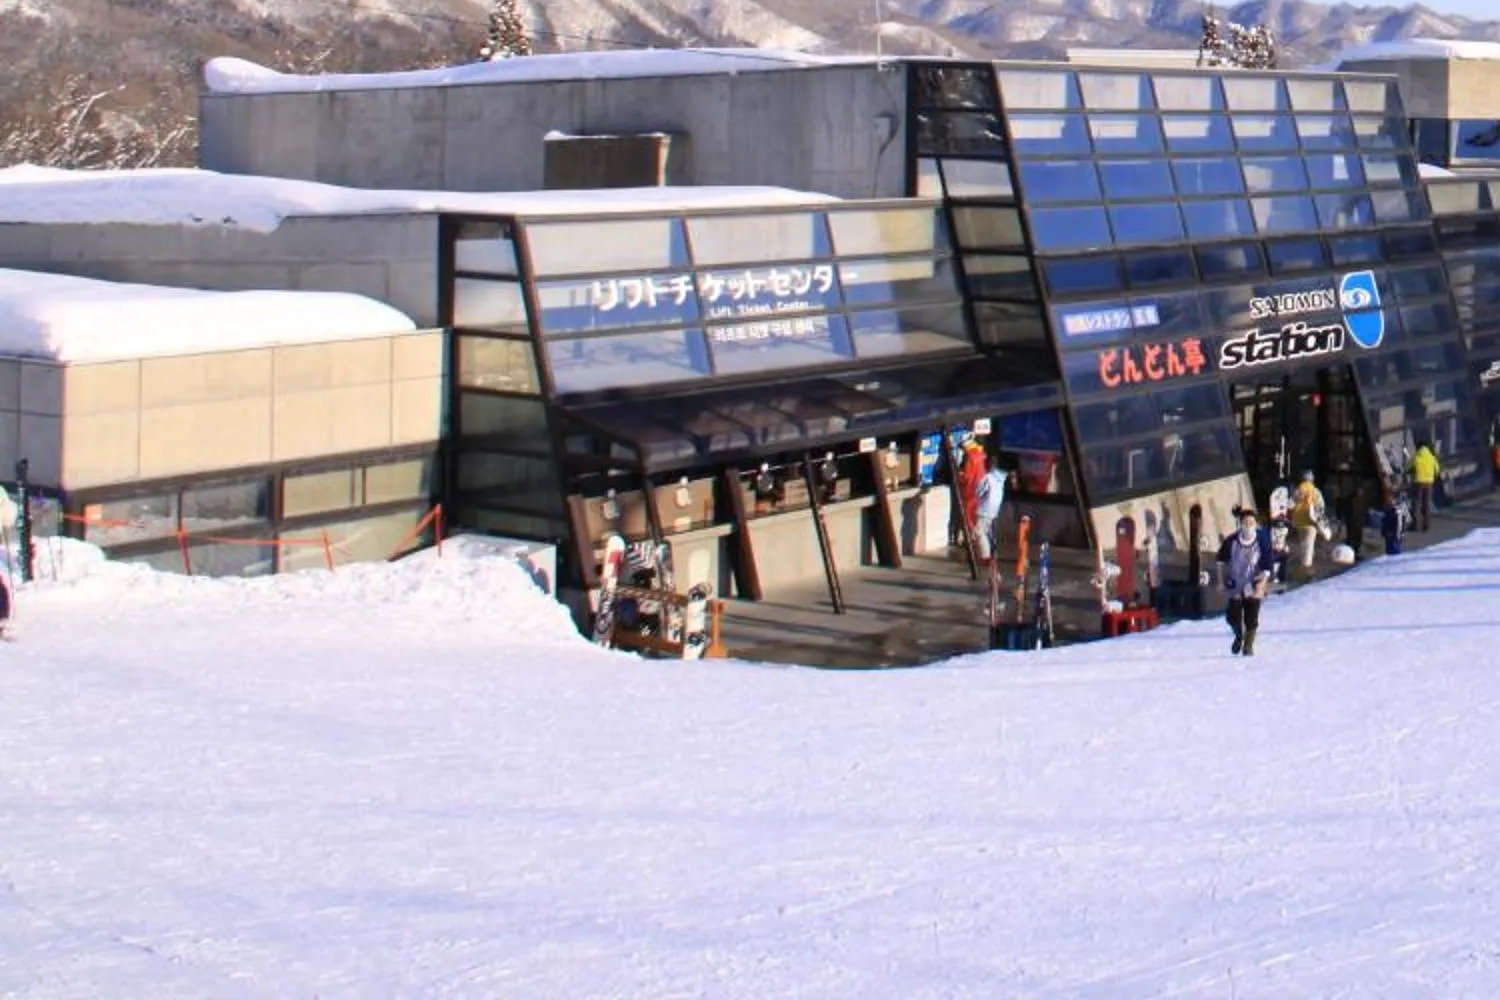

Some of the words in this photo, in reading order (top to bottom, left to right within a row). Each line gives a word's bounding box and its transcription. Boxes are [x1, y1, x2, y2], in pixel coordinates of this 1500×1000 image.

[592, 264, 858, 311] リフトチケットセンター
[1249, 288, 1337, 319] SALOMON
[1098, 337, 1206, 388] どんどん亭
[1219, 322, 1345, 369] station
